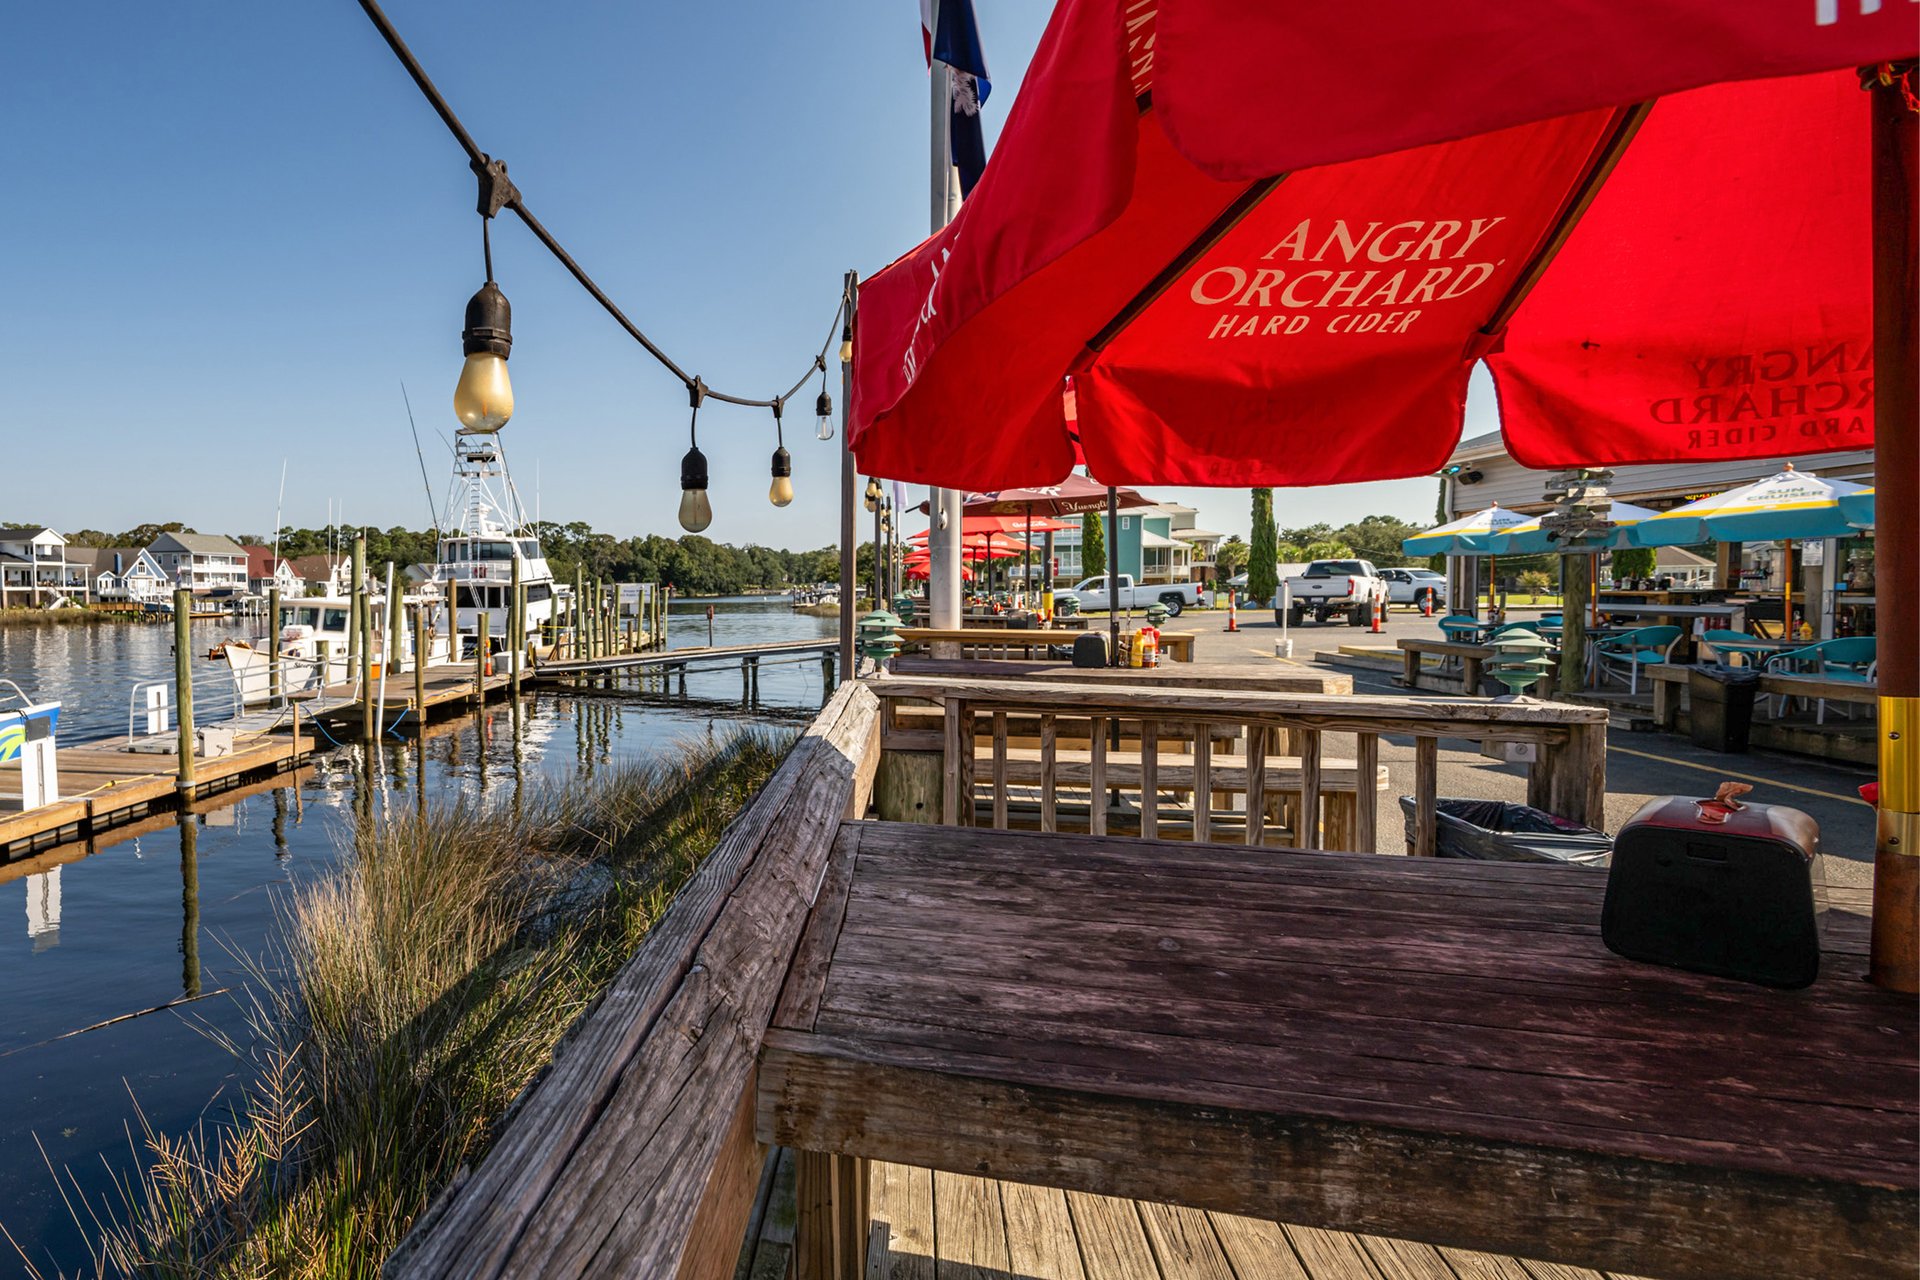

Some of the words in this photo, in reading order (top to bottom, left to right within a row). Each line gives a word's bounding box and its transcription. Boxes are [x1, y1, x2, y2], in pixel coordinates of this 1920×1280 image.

[1261, 216, 1506, 263] ANGRY
[1190, 263, 1495, 308] ORCHARD
[1208, 314, 1310, 339] HARD
[1326, 309, 1421, 334] CIDER
[1061, 496, 1121, 512] Yuengli
